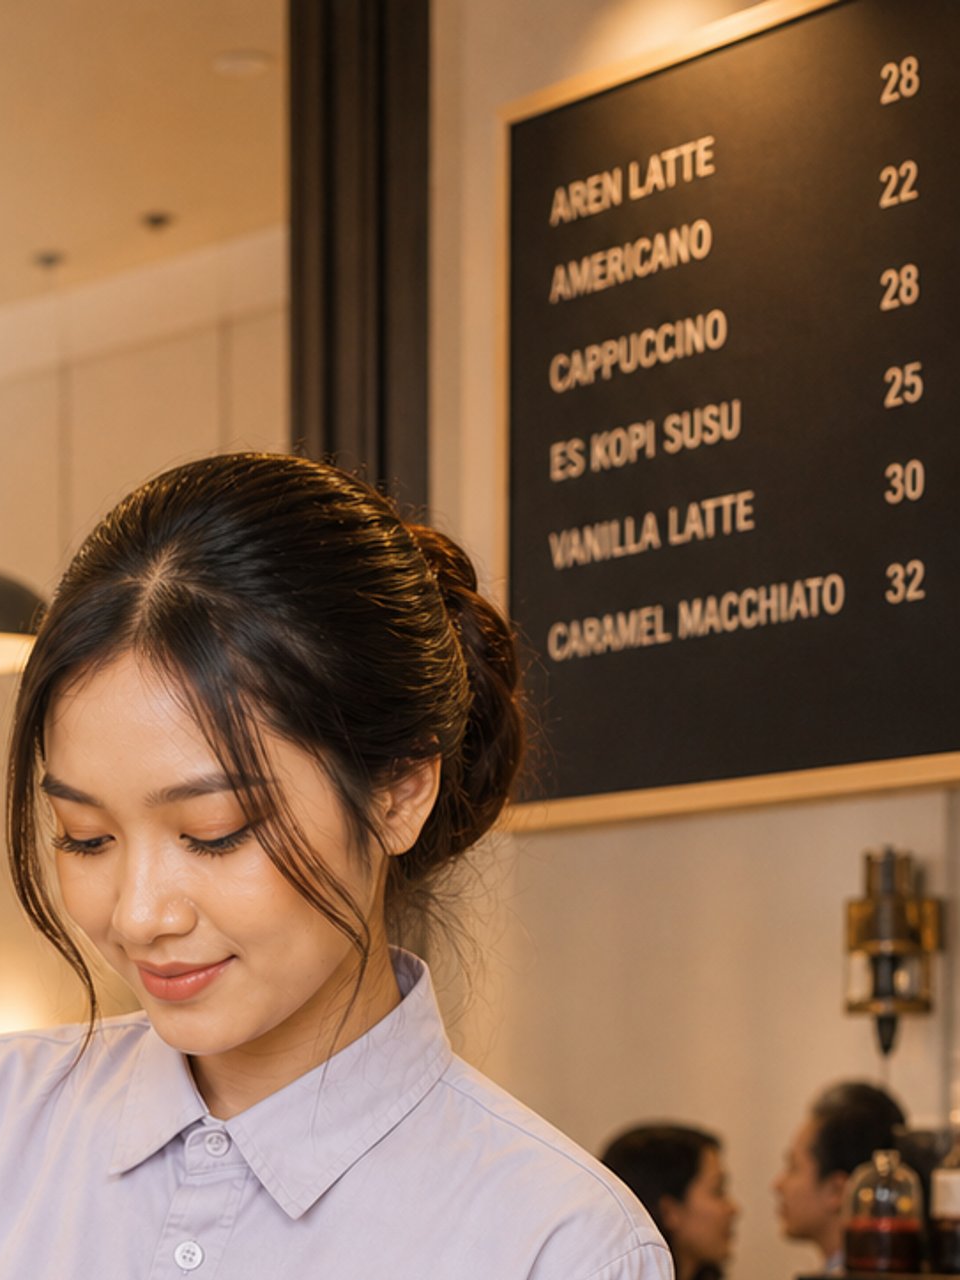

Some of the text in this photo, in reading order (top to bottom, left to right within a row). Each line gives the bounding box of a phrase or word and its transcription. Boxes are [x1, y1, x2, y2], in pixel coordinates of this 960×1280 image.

[880, 56, 919, 104] 28
[549, 135, 715, 227] AREN LATTE
[879, 160, 918, 208] 22
[549, 219, 712, 304] AMERICANO
[880, 264, 919, 310] 28
[549, 309, 727, 393] CAPPUCCINO
[884, 362, 923, 408] 25
[550, 399, 741, 482] ES KOPI SUSU
[884, 459, 924, 504] 30
[549, 490, 755, 569] VANILLA LATTE
[885, 559, 925, 604] 32
[548, 574, 844, 661] CARAMEL MACCHIATO
